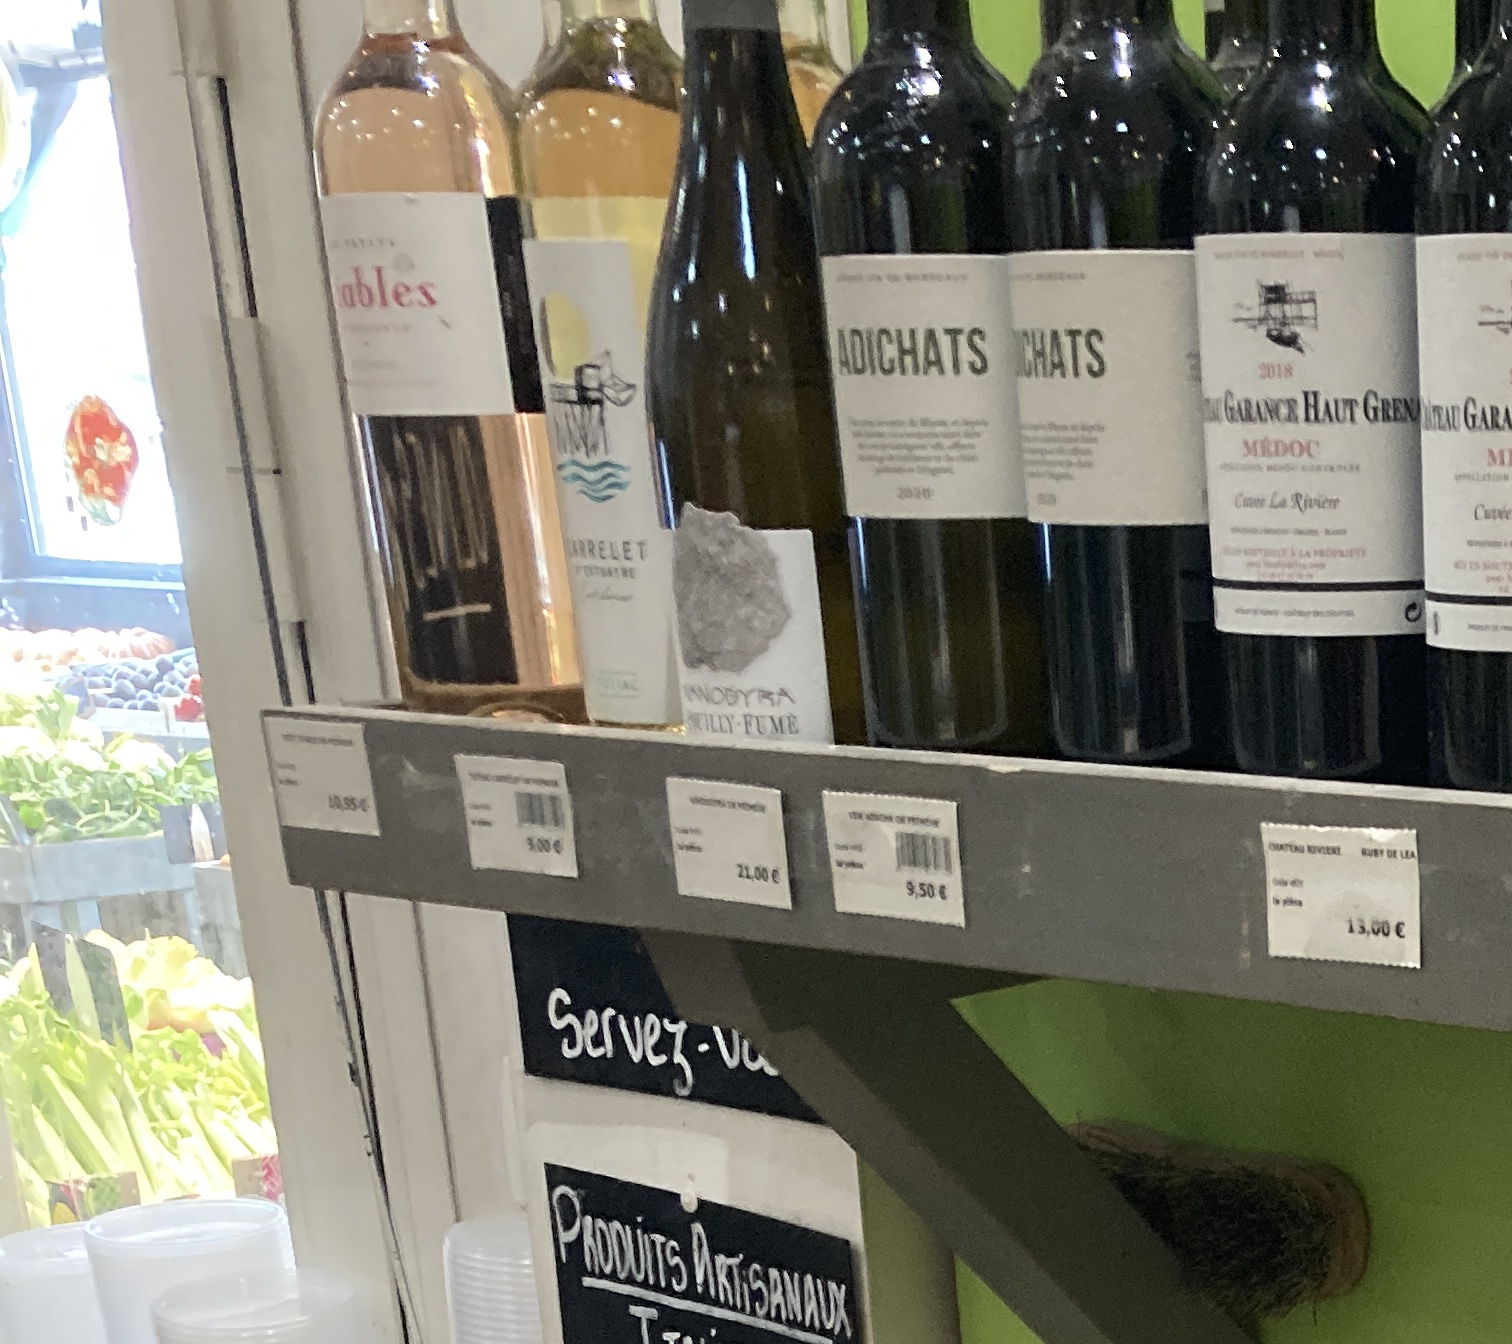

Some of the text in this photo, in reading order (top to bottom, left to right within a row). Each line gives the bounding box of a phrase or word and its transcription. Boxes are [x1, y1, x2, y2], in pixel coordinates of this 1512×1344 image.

[1301, 389, 1360, 424] HAUT
[1242, 435, 1320, 459] MÉDOC
[905, 880, 936, 900] 9,50
[1347, 917, 1407, 939] 13,00 €
